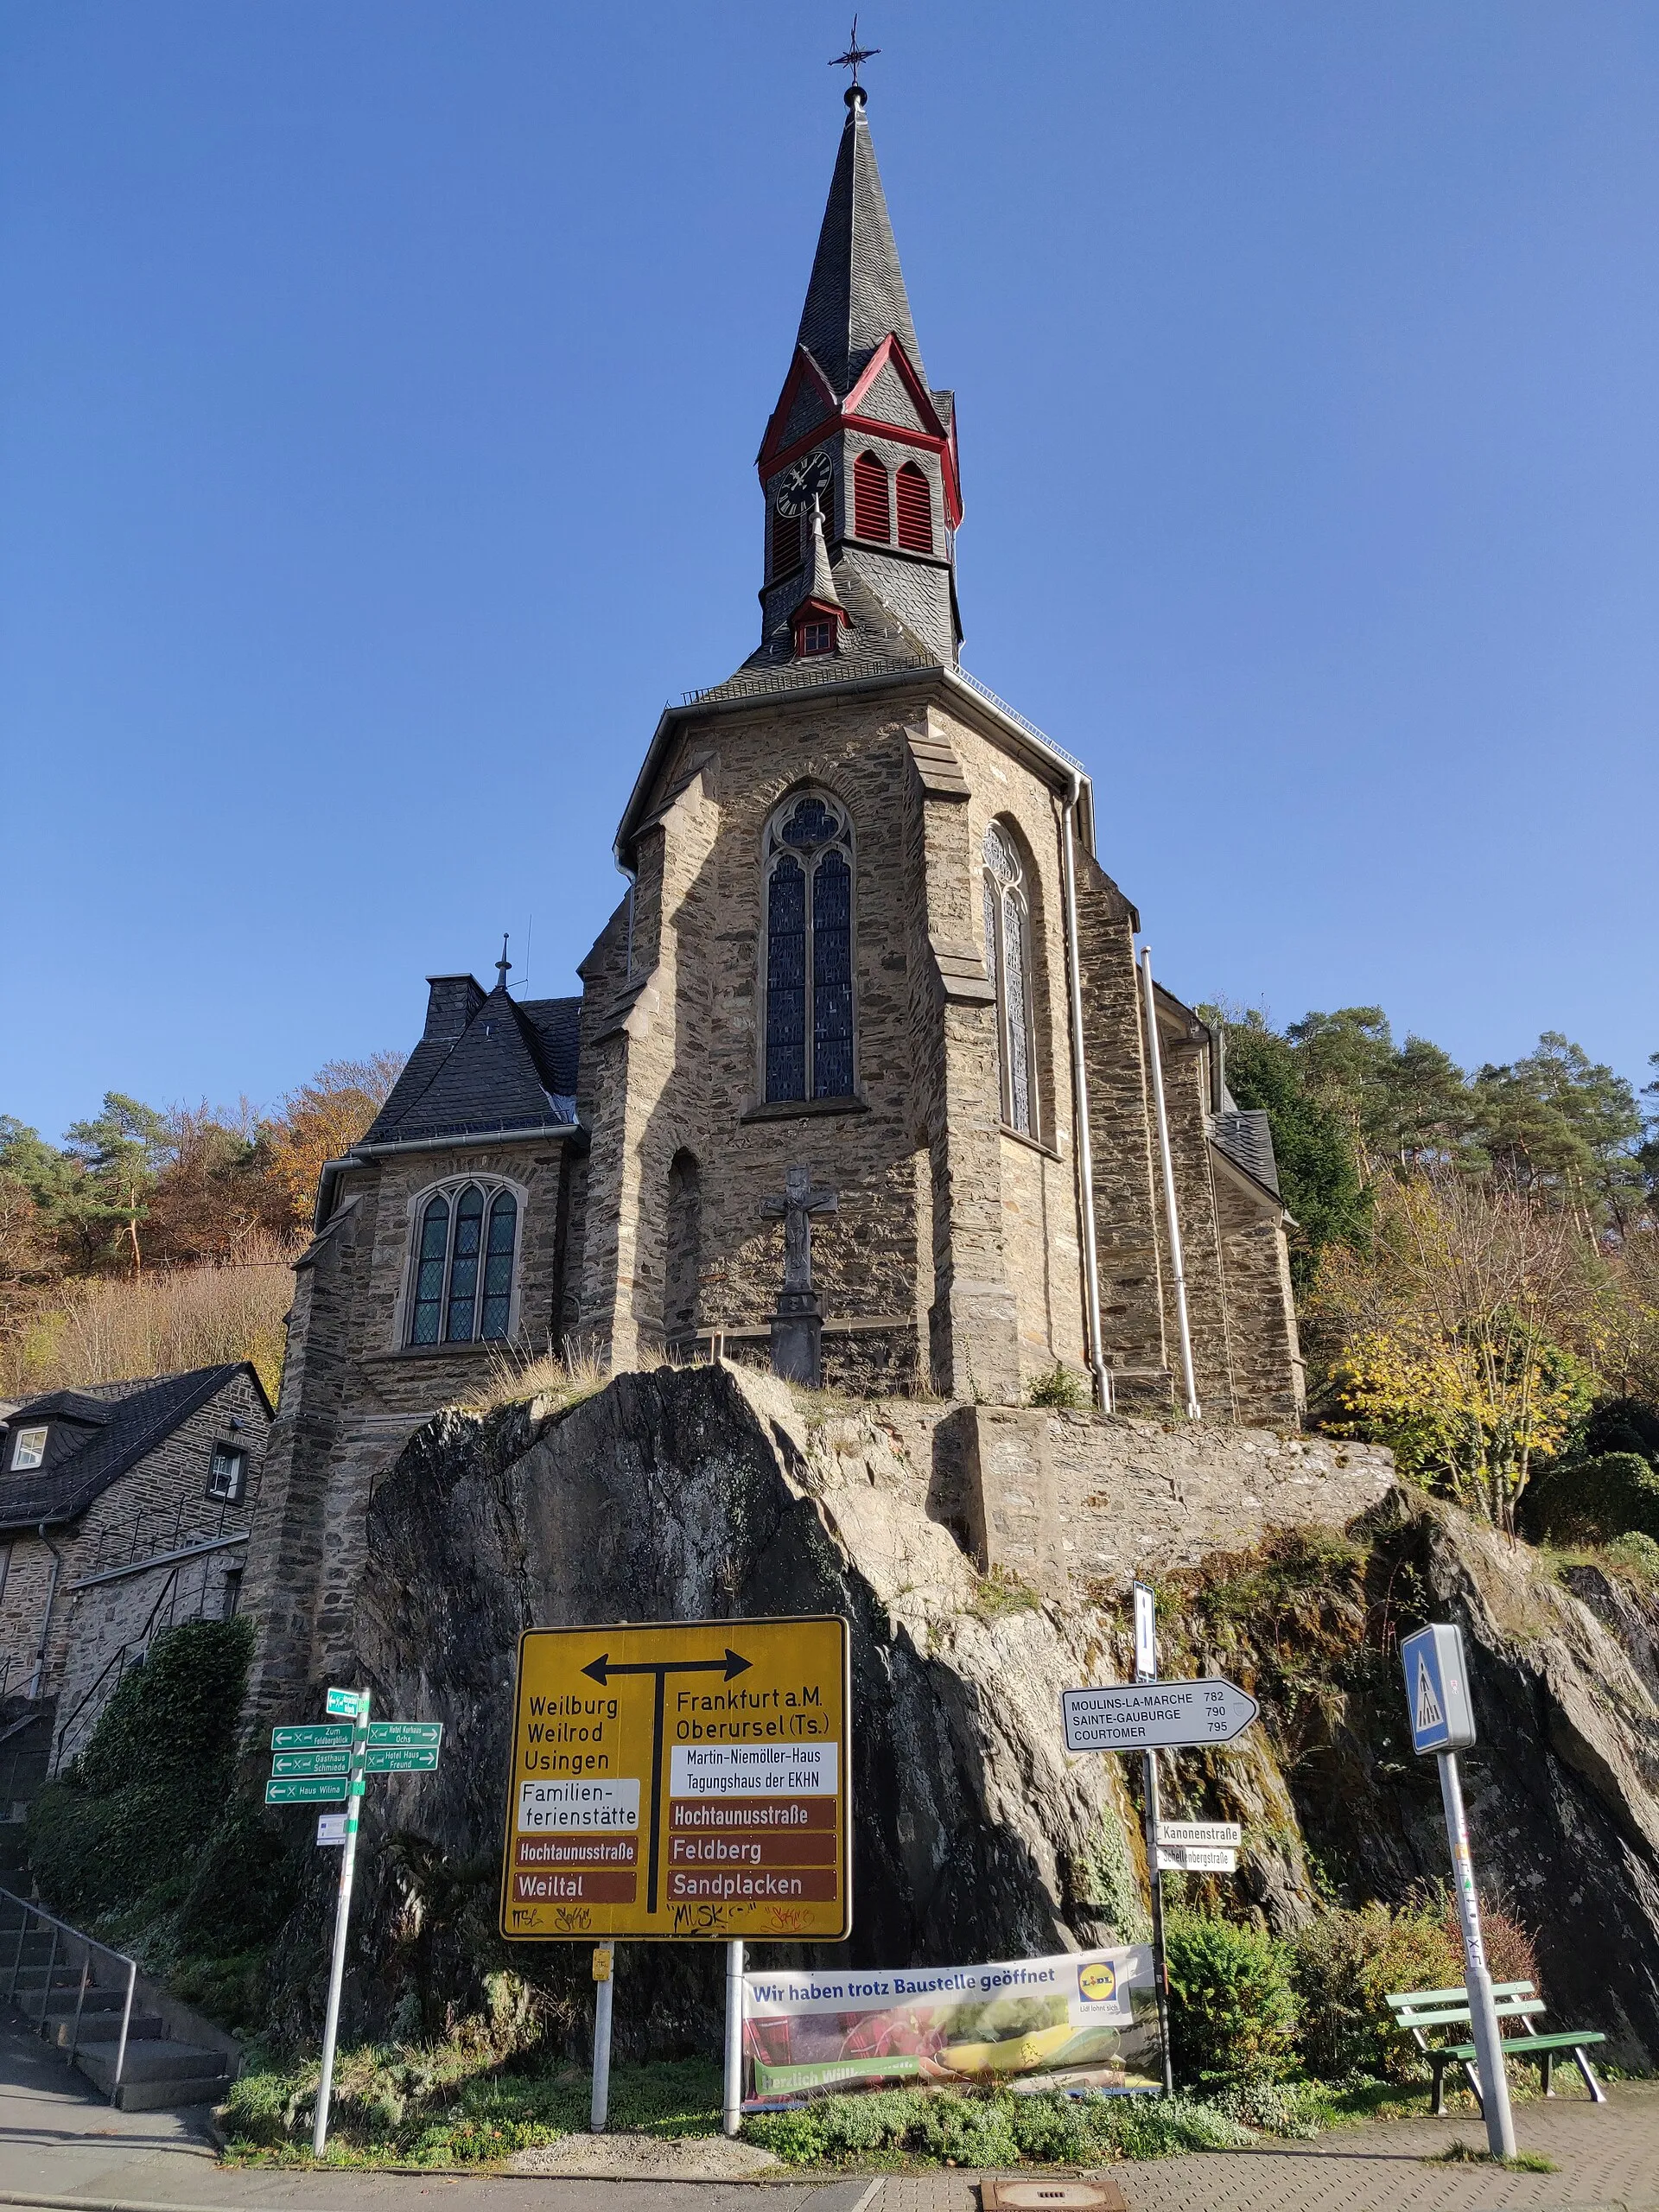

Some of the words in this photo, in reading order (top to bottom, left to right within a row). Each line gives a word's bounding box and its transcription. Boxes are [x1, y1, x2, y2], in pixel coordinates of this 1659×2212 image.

[529, 1695, 618, 1719] Weilburg
[677, 1688, 779, 1712] Frankfurt
[785, 1686, 823, 1707] a.M.
[1071, 1693, 1193, 1712] MOULINS-LA-MARCHE
[1204, 1691, 1224, 1702] 782
[677, 1714, 785, 1739] Oberursel
[790, 1712, 830, 1737] (Ts.)
[1072, 1709, 1181, 1726] SAINTE-GAUBURGE
[1205, 1706, 1226, 1717] 790
[325, 1727, 340, 1736] Zum
[389, 1726, 401, 1734] Hotel
[403, 1726, 422, 1734] Kurhaus
[396, 1735, 411, 1744] Ochs
[527, 1721, 603, 1744] Weilrod
[1074, 1726, 1146, 1741] COURTOMER
[1207, 1721, 1228, 1732] 795
[314, 1736, 348, 1745] Feldbergblick
[315, 1754, 346, 1763] Gasthaus
[385, 1751, 401, 1760] Hotel
[404, 1751, 419, 1759] Haus
[390, 1760, 411, 1769] Freund
[524, 1750, 609, 1775] Usingen
[687, 1747, 821, 1765] Martin-Niemöller-Haus
[314, 1763, 346, 1772] Schmiede
[299, 1786, 316, 1795] Haus
[319, 1785, 340, 1795] Wilina
[687, 1772, 761, 1793] Tagungshaus
[766, 1772, 785, 1789] der
[788, 1770, 819, 1788] EKHN
[522, 1783, 613, 1802] Familien-
[526, 1806, 636, 1826] ferienstätte
[674, 1804, 808, 1826] Hochtaunusstraße
[1163, 1825, 1237, 1840] Kanonenstraße
[520, 1841, 634, 1861] Hochtaunusstraße
[673, 1839, 761, 1865] Feldberg
[1164, 1849, 1229, 1866] Schellenbergstraße
[518, 1876, 583, 1897] Weiltal
[673, 1873, 802, 1900] Sandplacken
[753, 1984, 785, 2003] Wir
[789, 1983, 843, 2001] haben
[848, 1980, 889, 1997] trotz
[893, 1974, 976, 1994] Baustelle
[980, 1967, 1055, 1992] geöffnet
[761, 2071, 818, 2090] Herzlich
